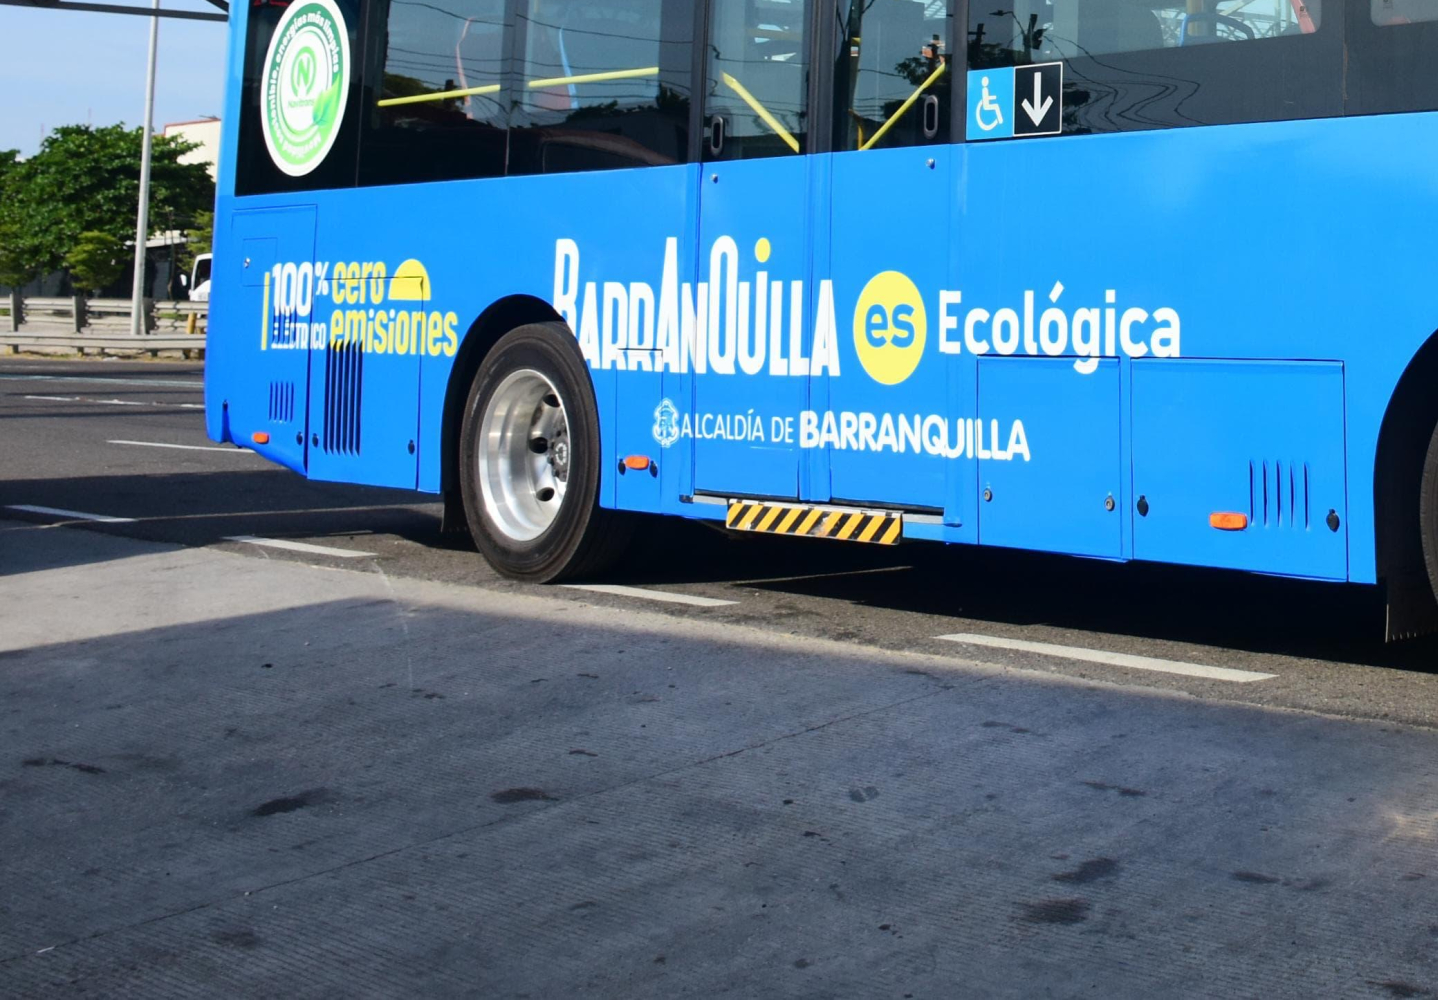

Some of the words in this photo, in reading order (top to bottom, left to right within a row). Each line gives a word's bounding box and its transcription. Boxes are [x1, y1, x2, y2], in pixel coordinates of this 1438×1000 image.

[276, 14, 307, 63] energías
[307, 11, 324, 27] más
[272, 261, 330, 317] 100%
[331, 261, 387, 304] cero
[329, 308, 459, 357] emisiones
[864, 303, 916, 349] es
[938, 280, 1181, 374] Ecológica
[681, 408, 765, 442] ALCALDÍA
[771, 416, 794, 443] DE
[800, 410, 1031, 461] BARRANQUILLA
